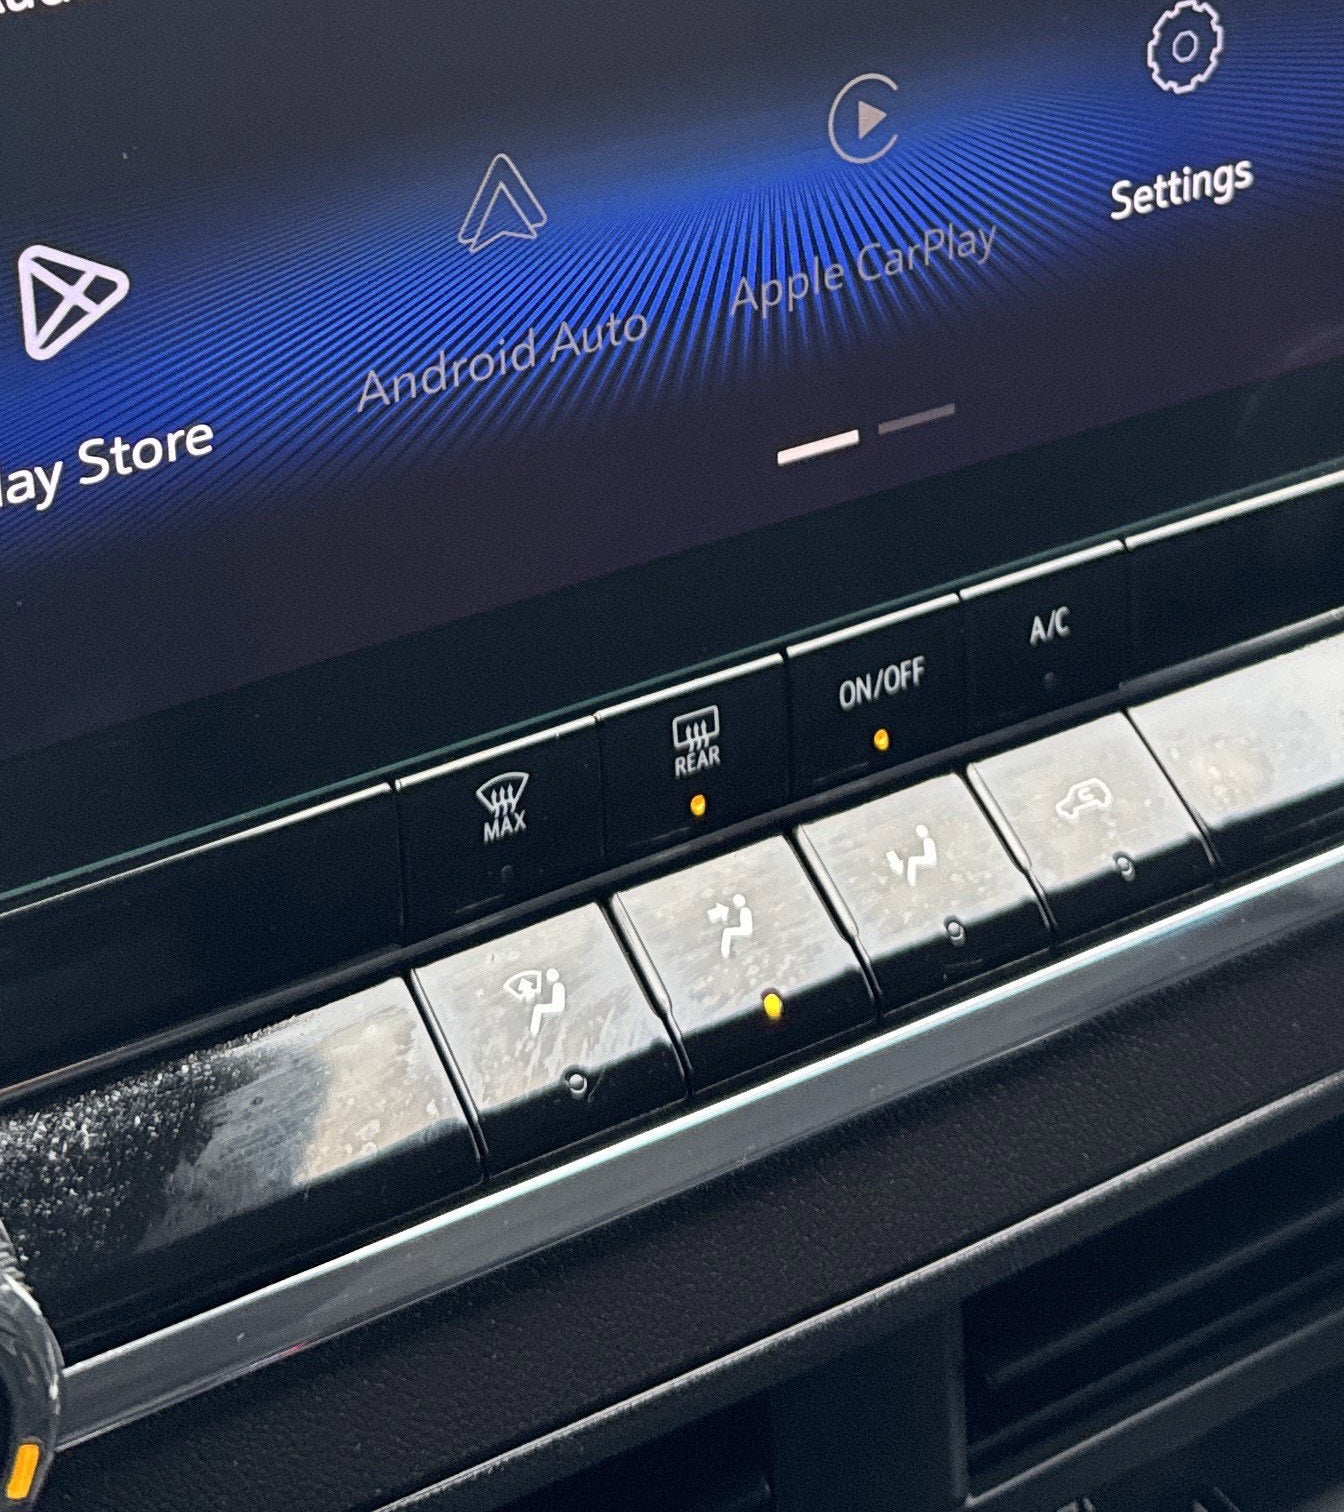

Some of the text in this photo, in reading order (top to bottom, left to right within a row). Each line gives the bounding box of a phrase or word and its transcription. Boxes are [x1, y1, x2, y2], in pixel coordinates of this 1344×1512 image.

[1110, 160, 1254, 220] Settings
[729, 222, 999, 319] Apple CarPlay
[356, 312, 651, 413] Android Auto
[77, 424, 214, 485] Store
[1029, 606, 1069, 643] A/C
[838, 655, 925, 709] ON/OFF
[673, 744, 721, 777] REAR
[482, 810, 528, 842] MAX
